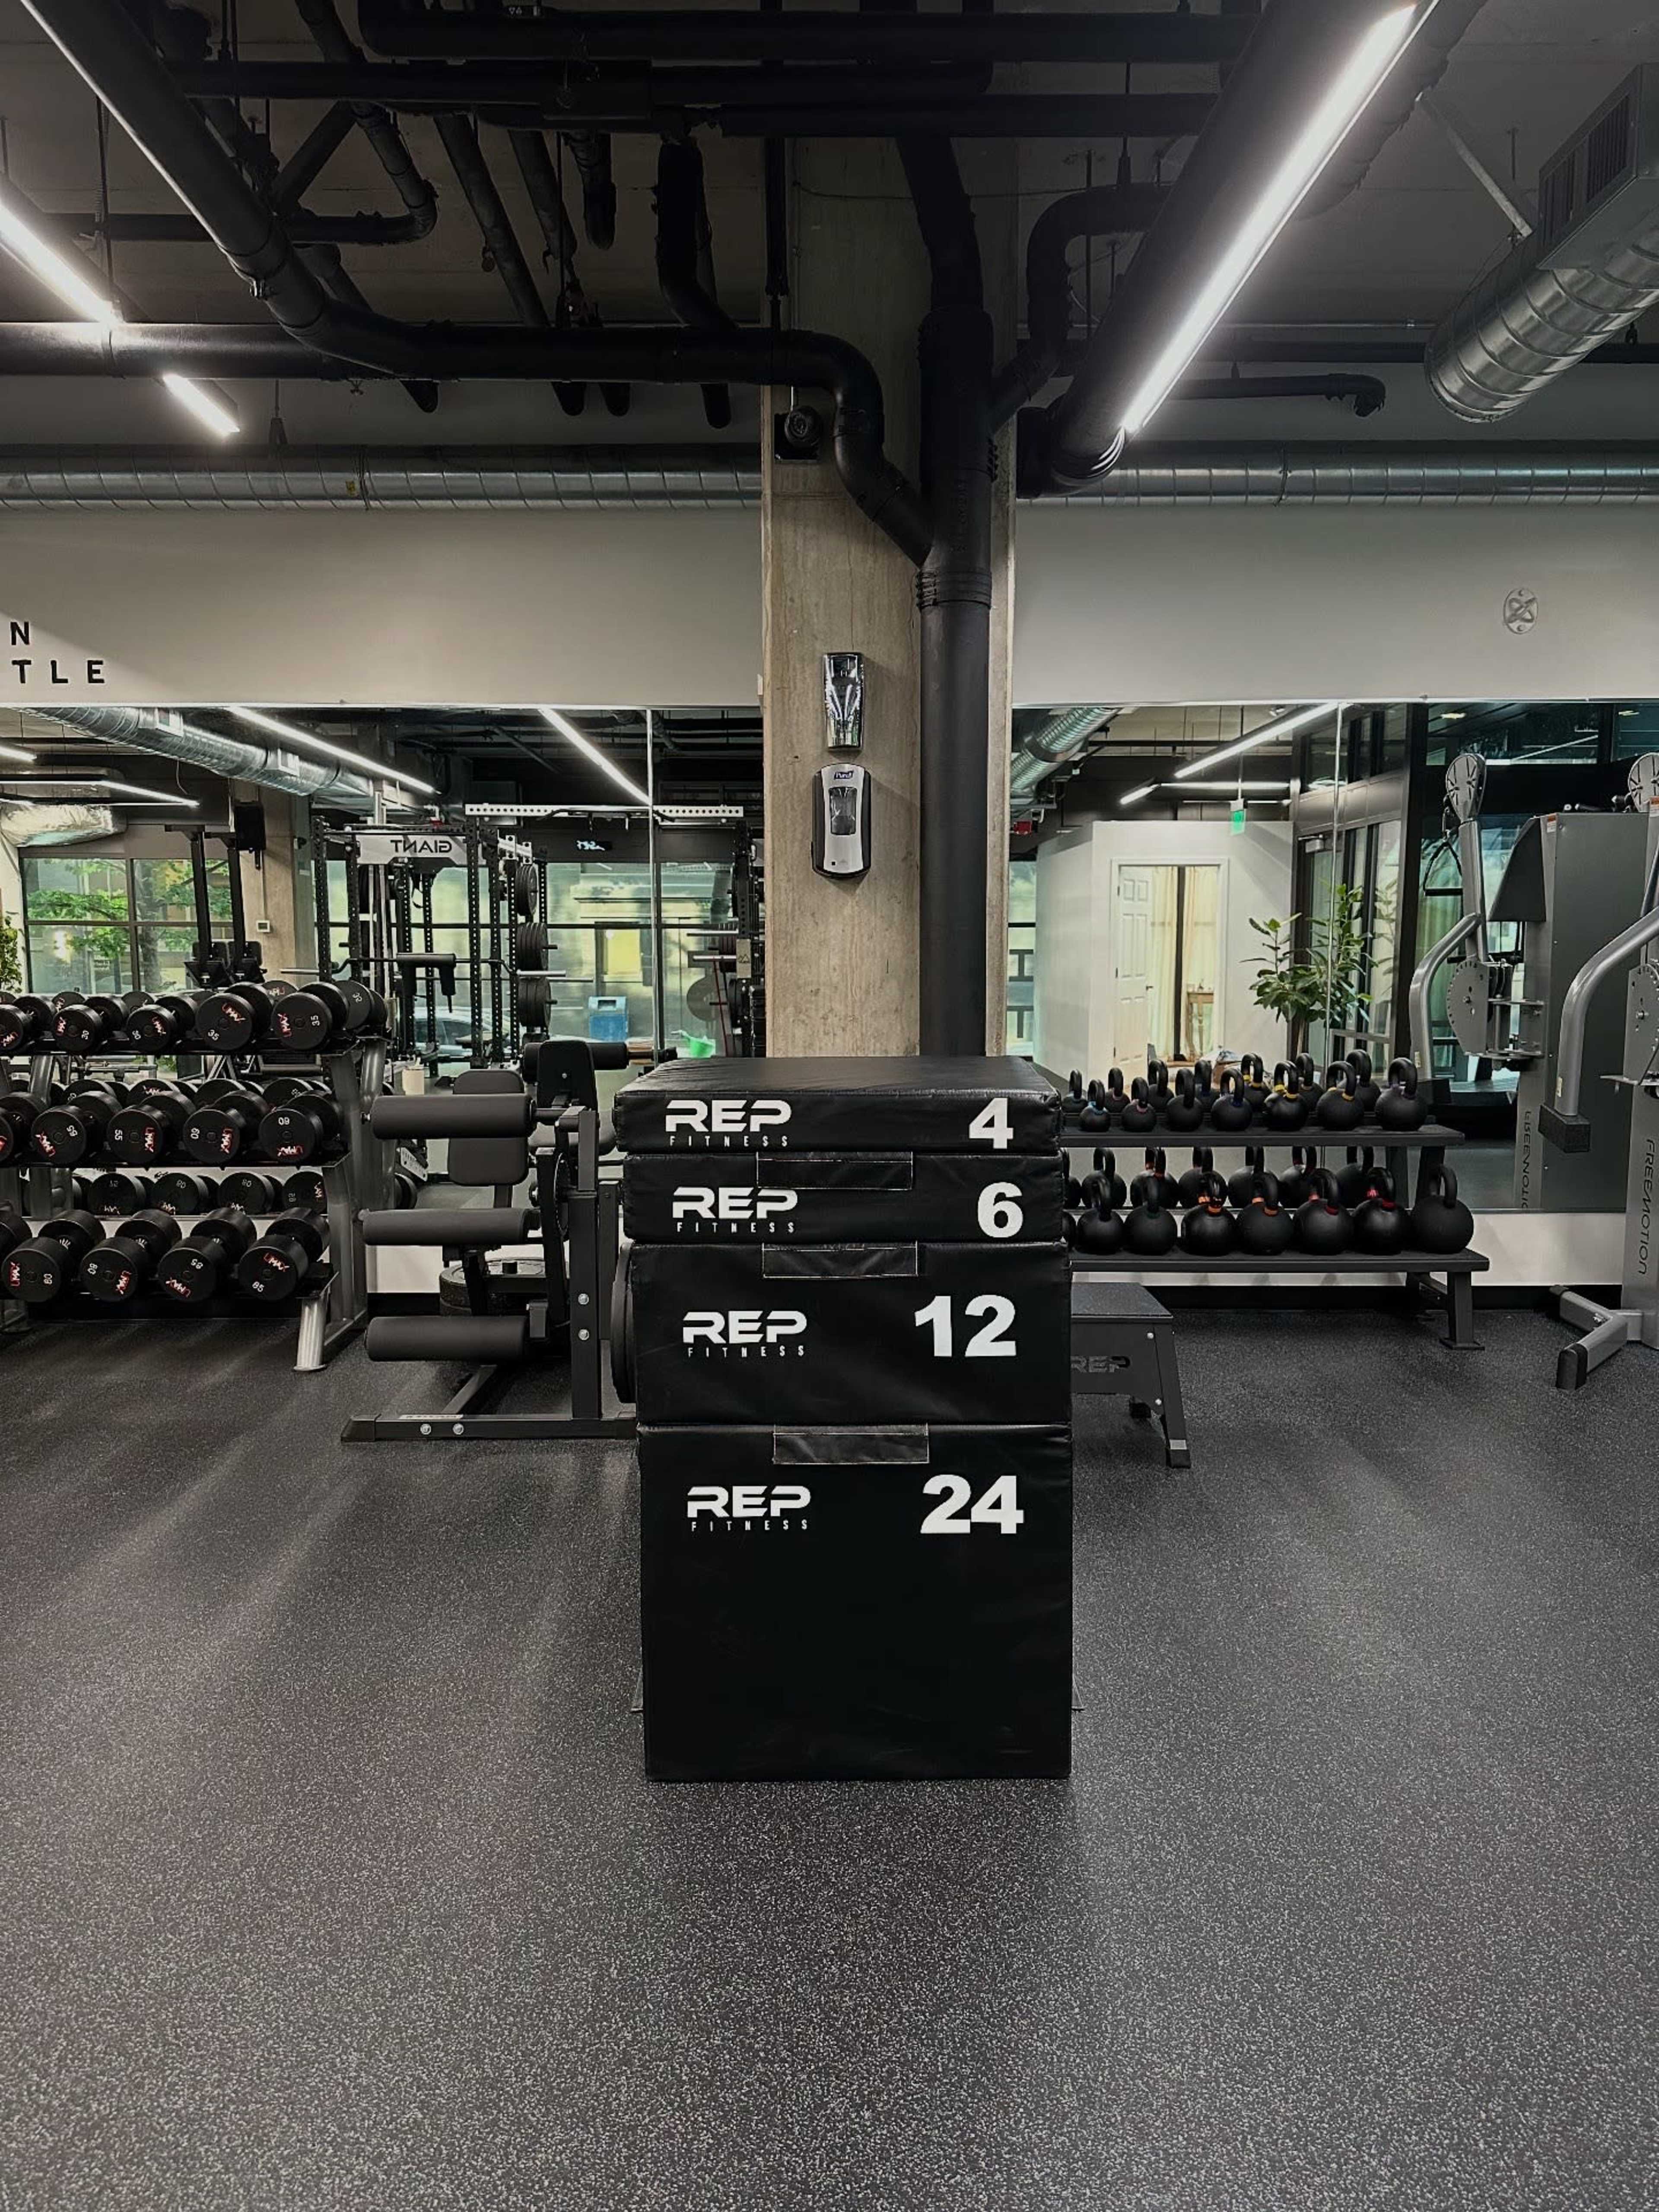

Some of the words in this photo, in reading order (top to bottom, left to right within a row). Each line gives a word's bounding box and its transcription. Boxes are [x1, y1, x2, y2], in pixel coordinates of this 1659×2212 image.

[10, 621, 30, 645] N
[11, 659, 105, 684] TLE
[221, 1002, 246, 1023] UMAX
[310, 1015, 320, 1026] 35
[207, 1029, 219, 1041] 35
[277, 1013, 292, 1038] UMAX
[665, 1100, 791, 1132] REP
[969, 1097, 1014, 1149] 4
[144, 1127, 155, 1153] UMAX
[277, 1145, 303, 1157] UMAX
[670, 1135, 787, 1147] FITNESS
[672, 1187, 798, 1219] REP
[978, 1182, 1023, 1238] 6
[1638, 1139, 1655, 1274] FREEMOTION
[677, 1222, 794, 1233] FITNESS
[10, 1262, 21, 1287] UMAX
[264, 1252, 290, 1272] UMAX
[165, 1277, 191, 1297] UMAX
[683, 1310, 807, 1344] REP
[914, 1294, 1017, 1357] 12
[688, 1345, 804, 1357] FITNESS
[687, 1486, 811, 1518] REP
[920, 1474, 1024, 1534] 24
[692, 1519, 807, 1532] FITNESS
